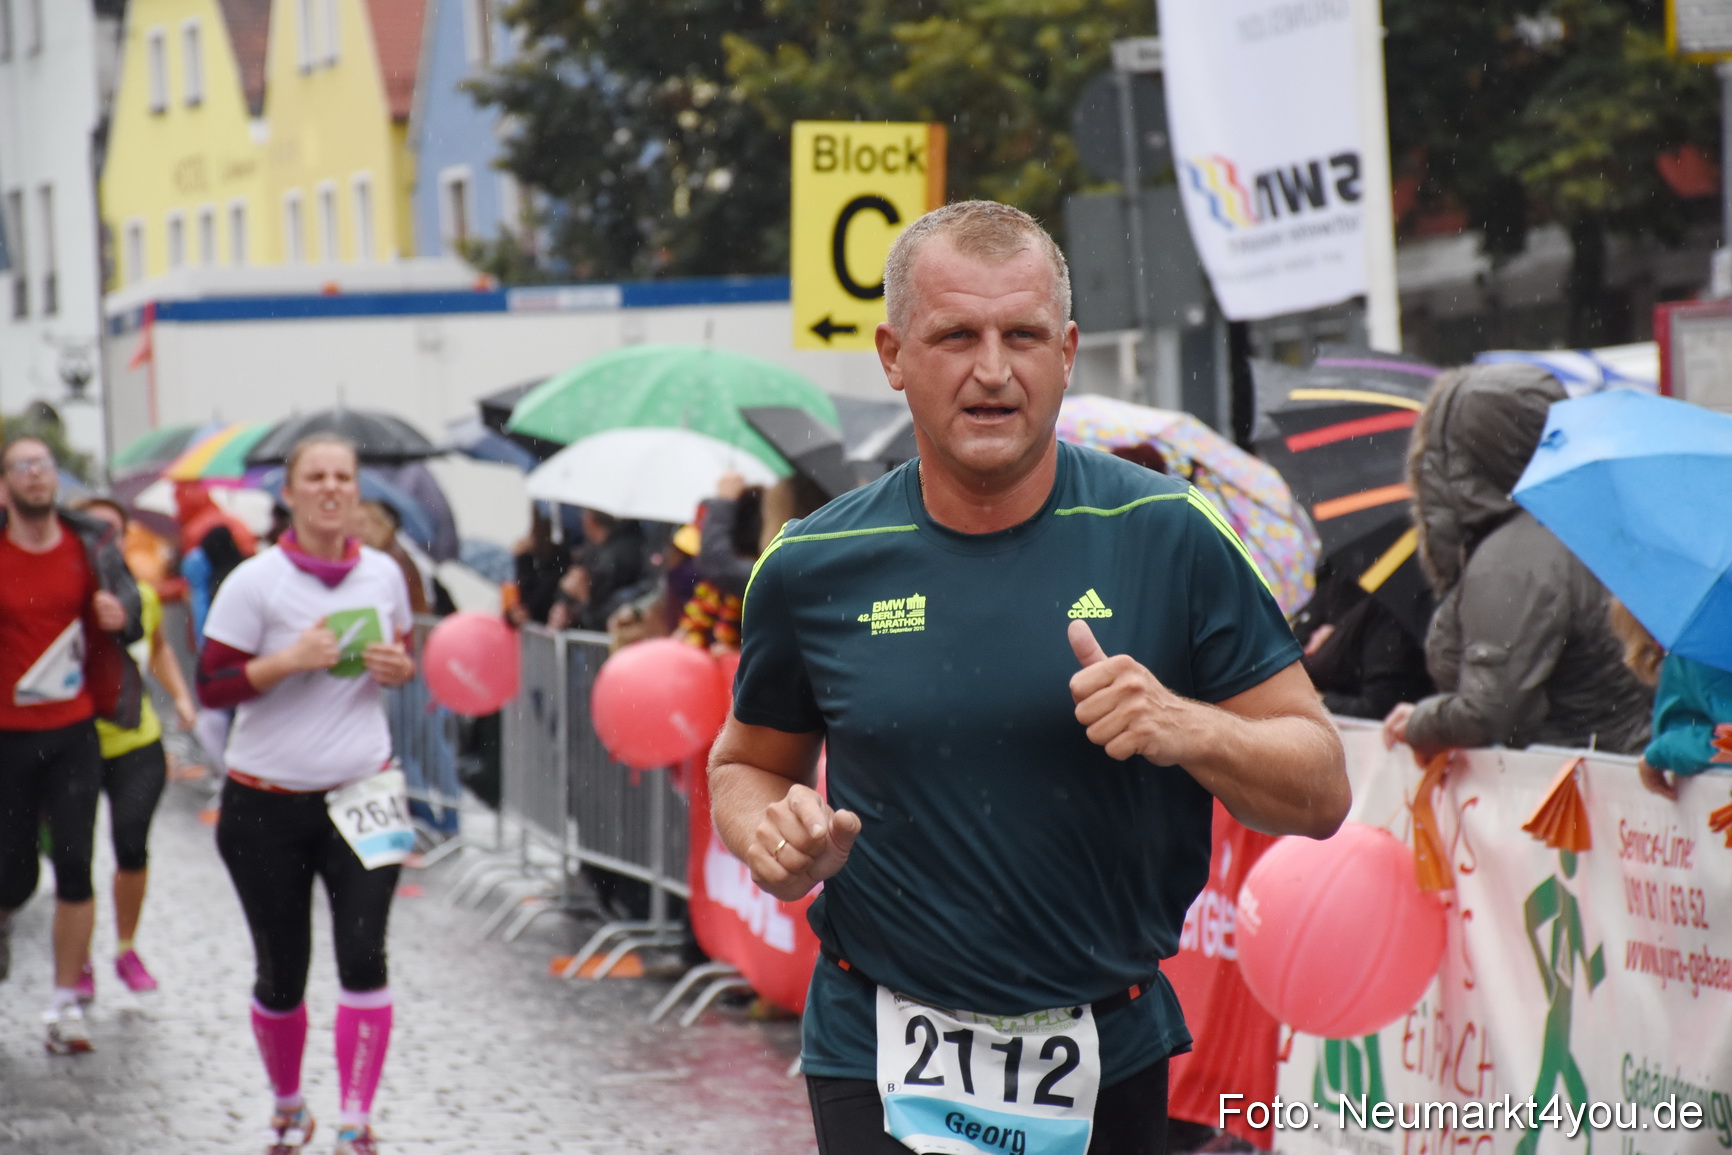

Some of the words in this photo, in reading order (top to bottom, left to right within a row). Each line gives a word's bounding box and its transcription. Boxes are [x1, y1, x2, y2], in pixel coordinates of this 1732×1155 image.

[812, 135, 927, 173] Block
[832, 195, 900, 300] C
[872, 598, 906, 612] BMW
[857, 613, 872, 623] 42.
[872, 610, 905, 621] BERLIN
[1067, 607, 1113, 619] adidas
[871, 617, 925, 629] MARATHON
[1016, 1025, 1039, 1035] smart
[1040, 1018, 1077, 1033] concepts
[904, 1014, 1081, 1109] 2112
[887, 1082, 896, 1093] B
[945, 1111, 1026, 1155] Georg
